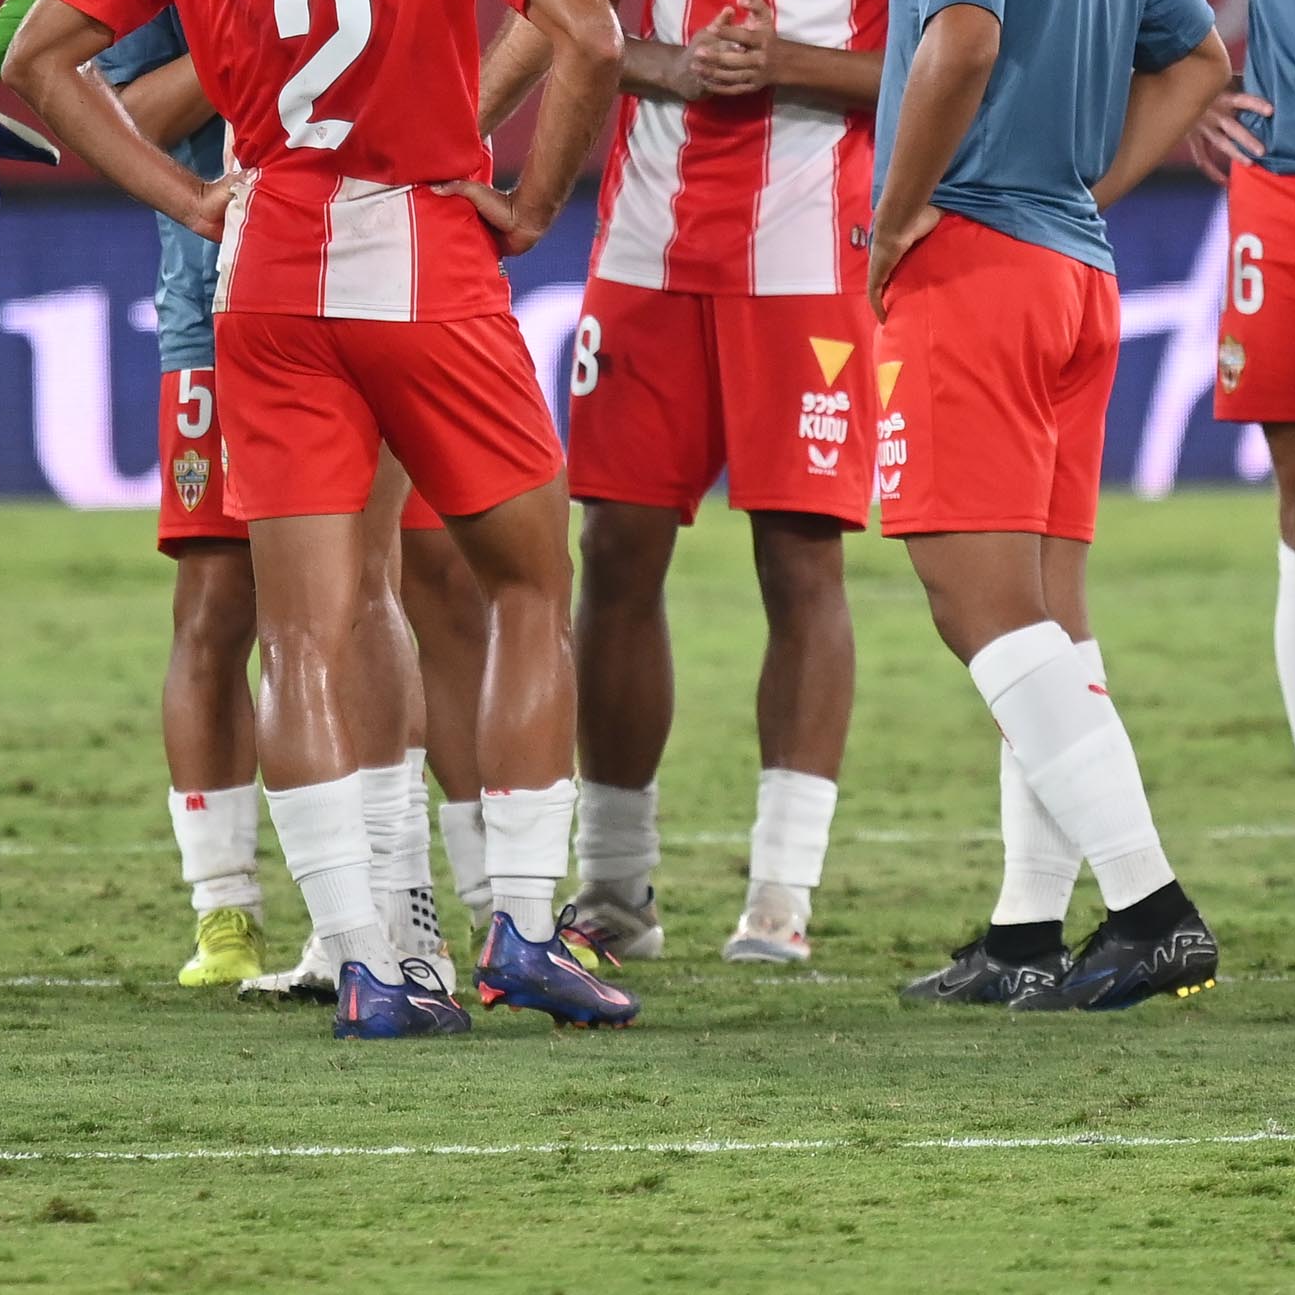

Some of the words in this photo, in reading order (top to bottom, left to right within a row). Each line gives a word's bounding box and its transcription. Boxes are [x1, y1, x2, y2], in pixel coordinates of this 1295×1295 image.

[570, 314, 602, 396] 8
[177, 368, 213, 439] 5
[799, 413, 849, 444] KUDU
